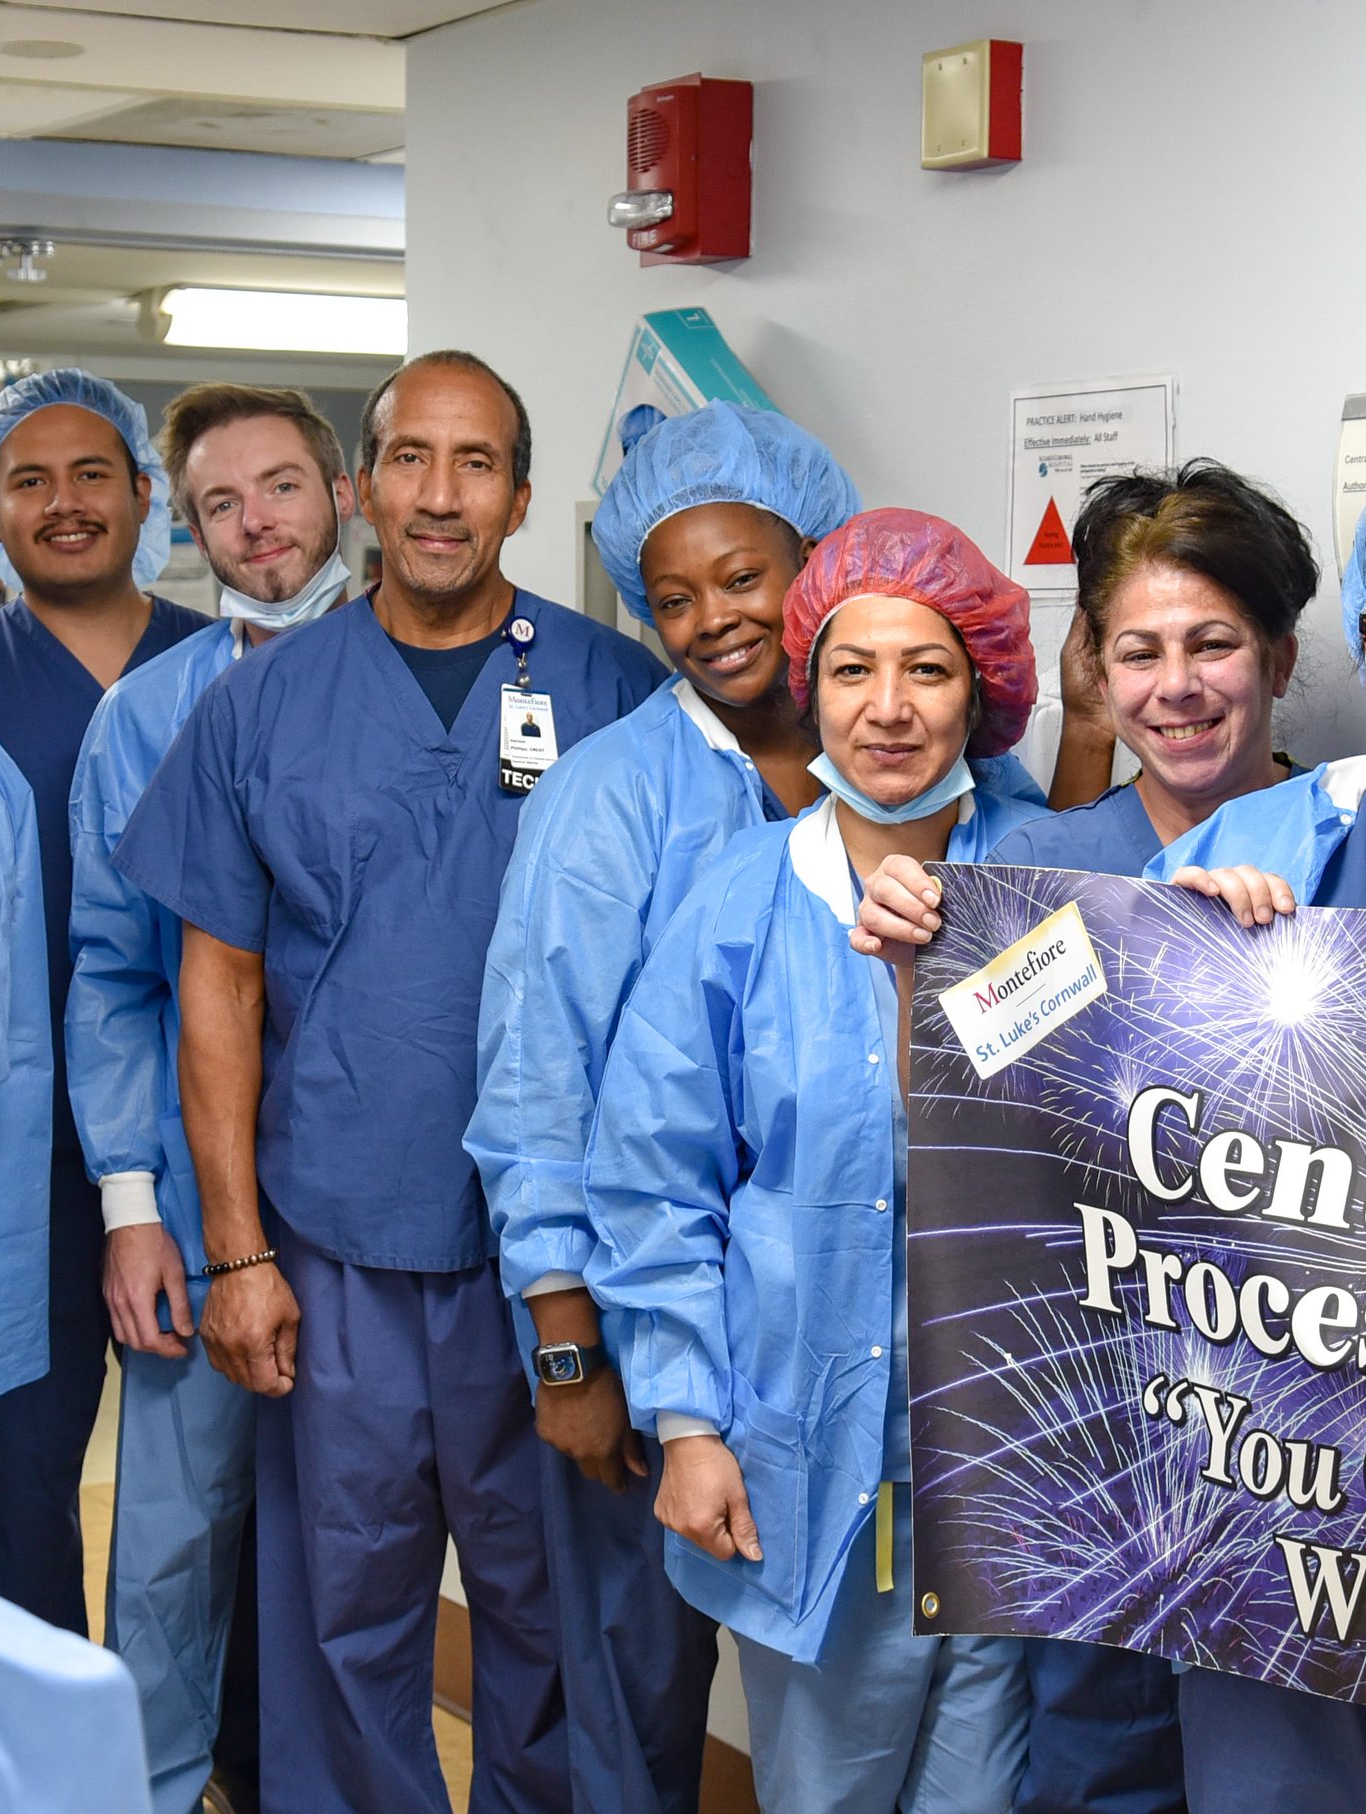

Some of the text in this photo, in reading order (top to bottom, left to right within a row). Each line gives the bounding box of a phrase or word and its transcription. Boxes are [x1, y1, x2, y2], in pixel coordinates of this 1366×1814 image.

[1026, 411, 1123, 426] PRACTICE ALERT: Hand Hygiene
[1024, 437, 1050, 447] Effective
[1094, 432, 1102, 442] All
[1103, 431, 1118, 442] Staff
[515, 623, 531, 638] M
[502, 768, 539, 790] TEC
[972, 939, 1067, 1014] Montefiore
[976, 964, 1097, 1062] St. Luke’s Cornwall
[1141, 1374, 1344, 1512] “You
